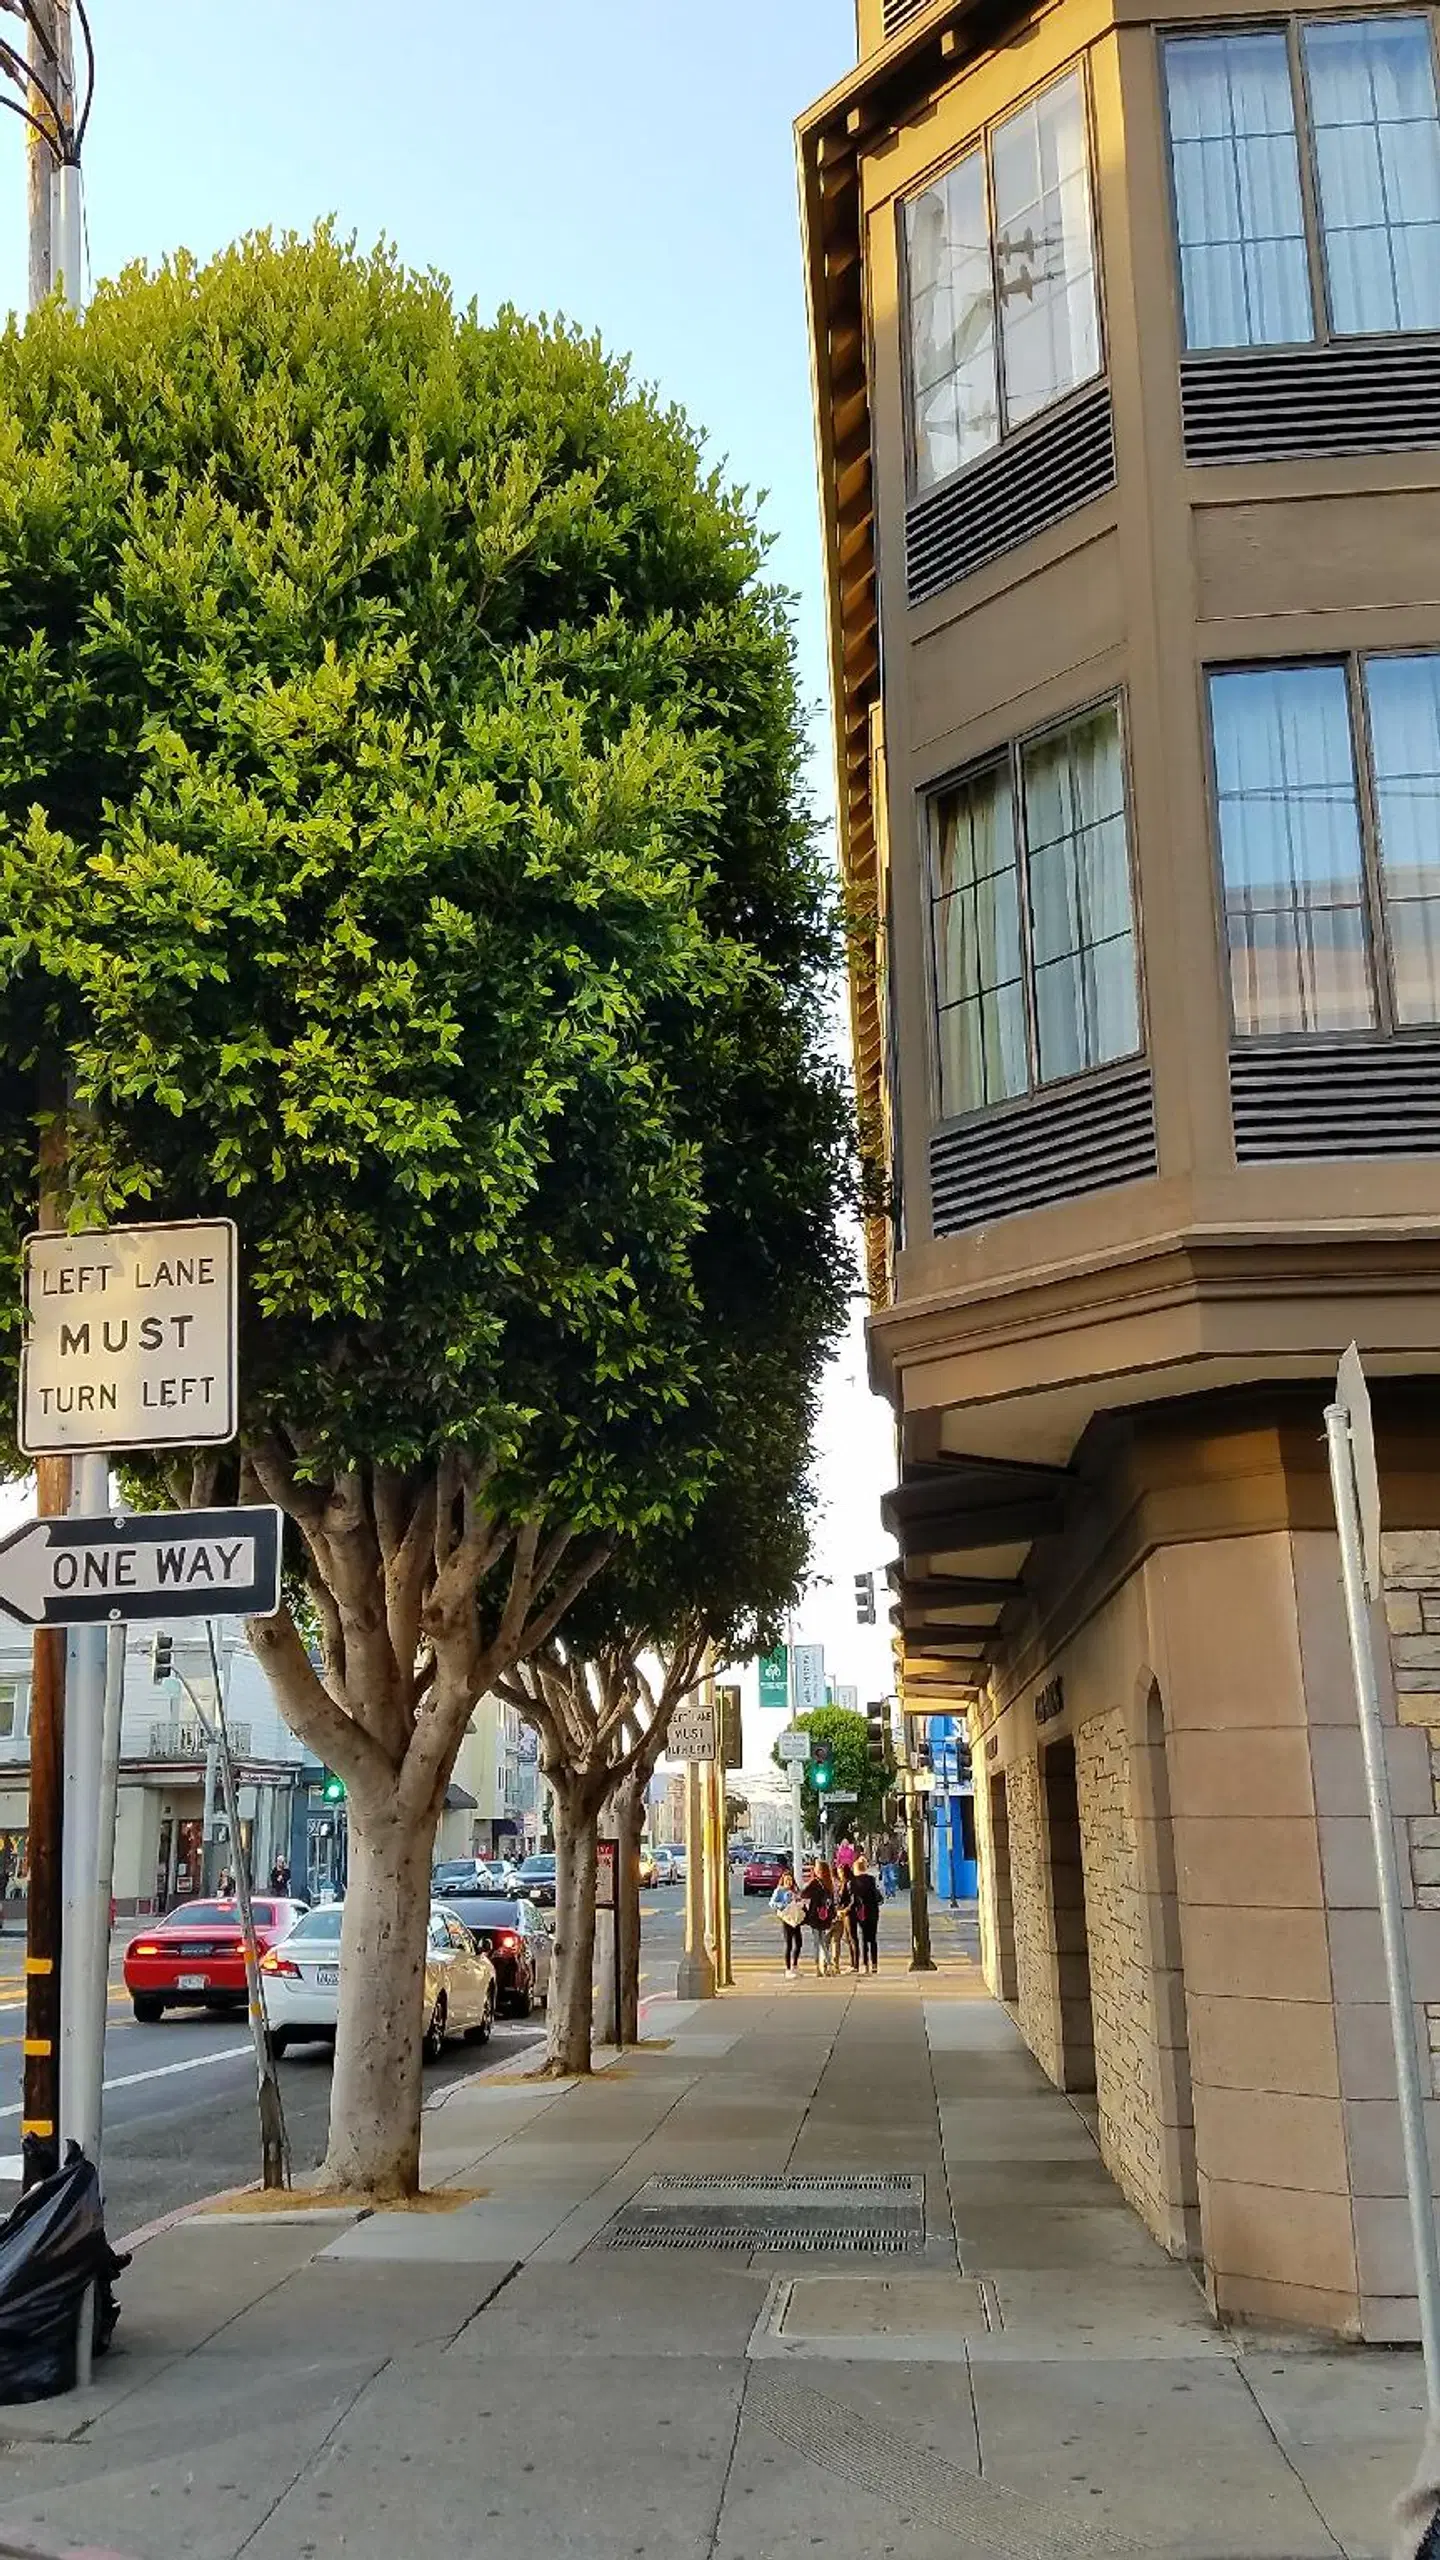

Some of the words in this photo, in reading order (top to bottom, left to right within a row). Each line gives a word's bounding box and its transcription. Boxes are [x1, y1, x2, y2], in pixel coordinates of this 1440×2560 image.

[42, 1265, 113, 1296] LEFT
[135, 1258, 215, 1289] LANE
[60, 1315, 193, 1356] MUST
[39, 1384, 116, 1414] TURN
[143, 1377, 214, 1408] LEFT
[53, 1551, 136, 1589] ONE
[156, 1544, 243, 1584] WAY
[675, 1728, 703, 1740] MUST
